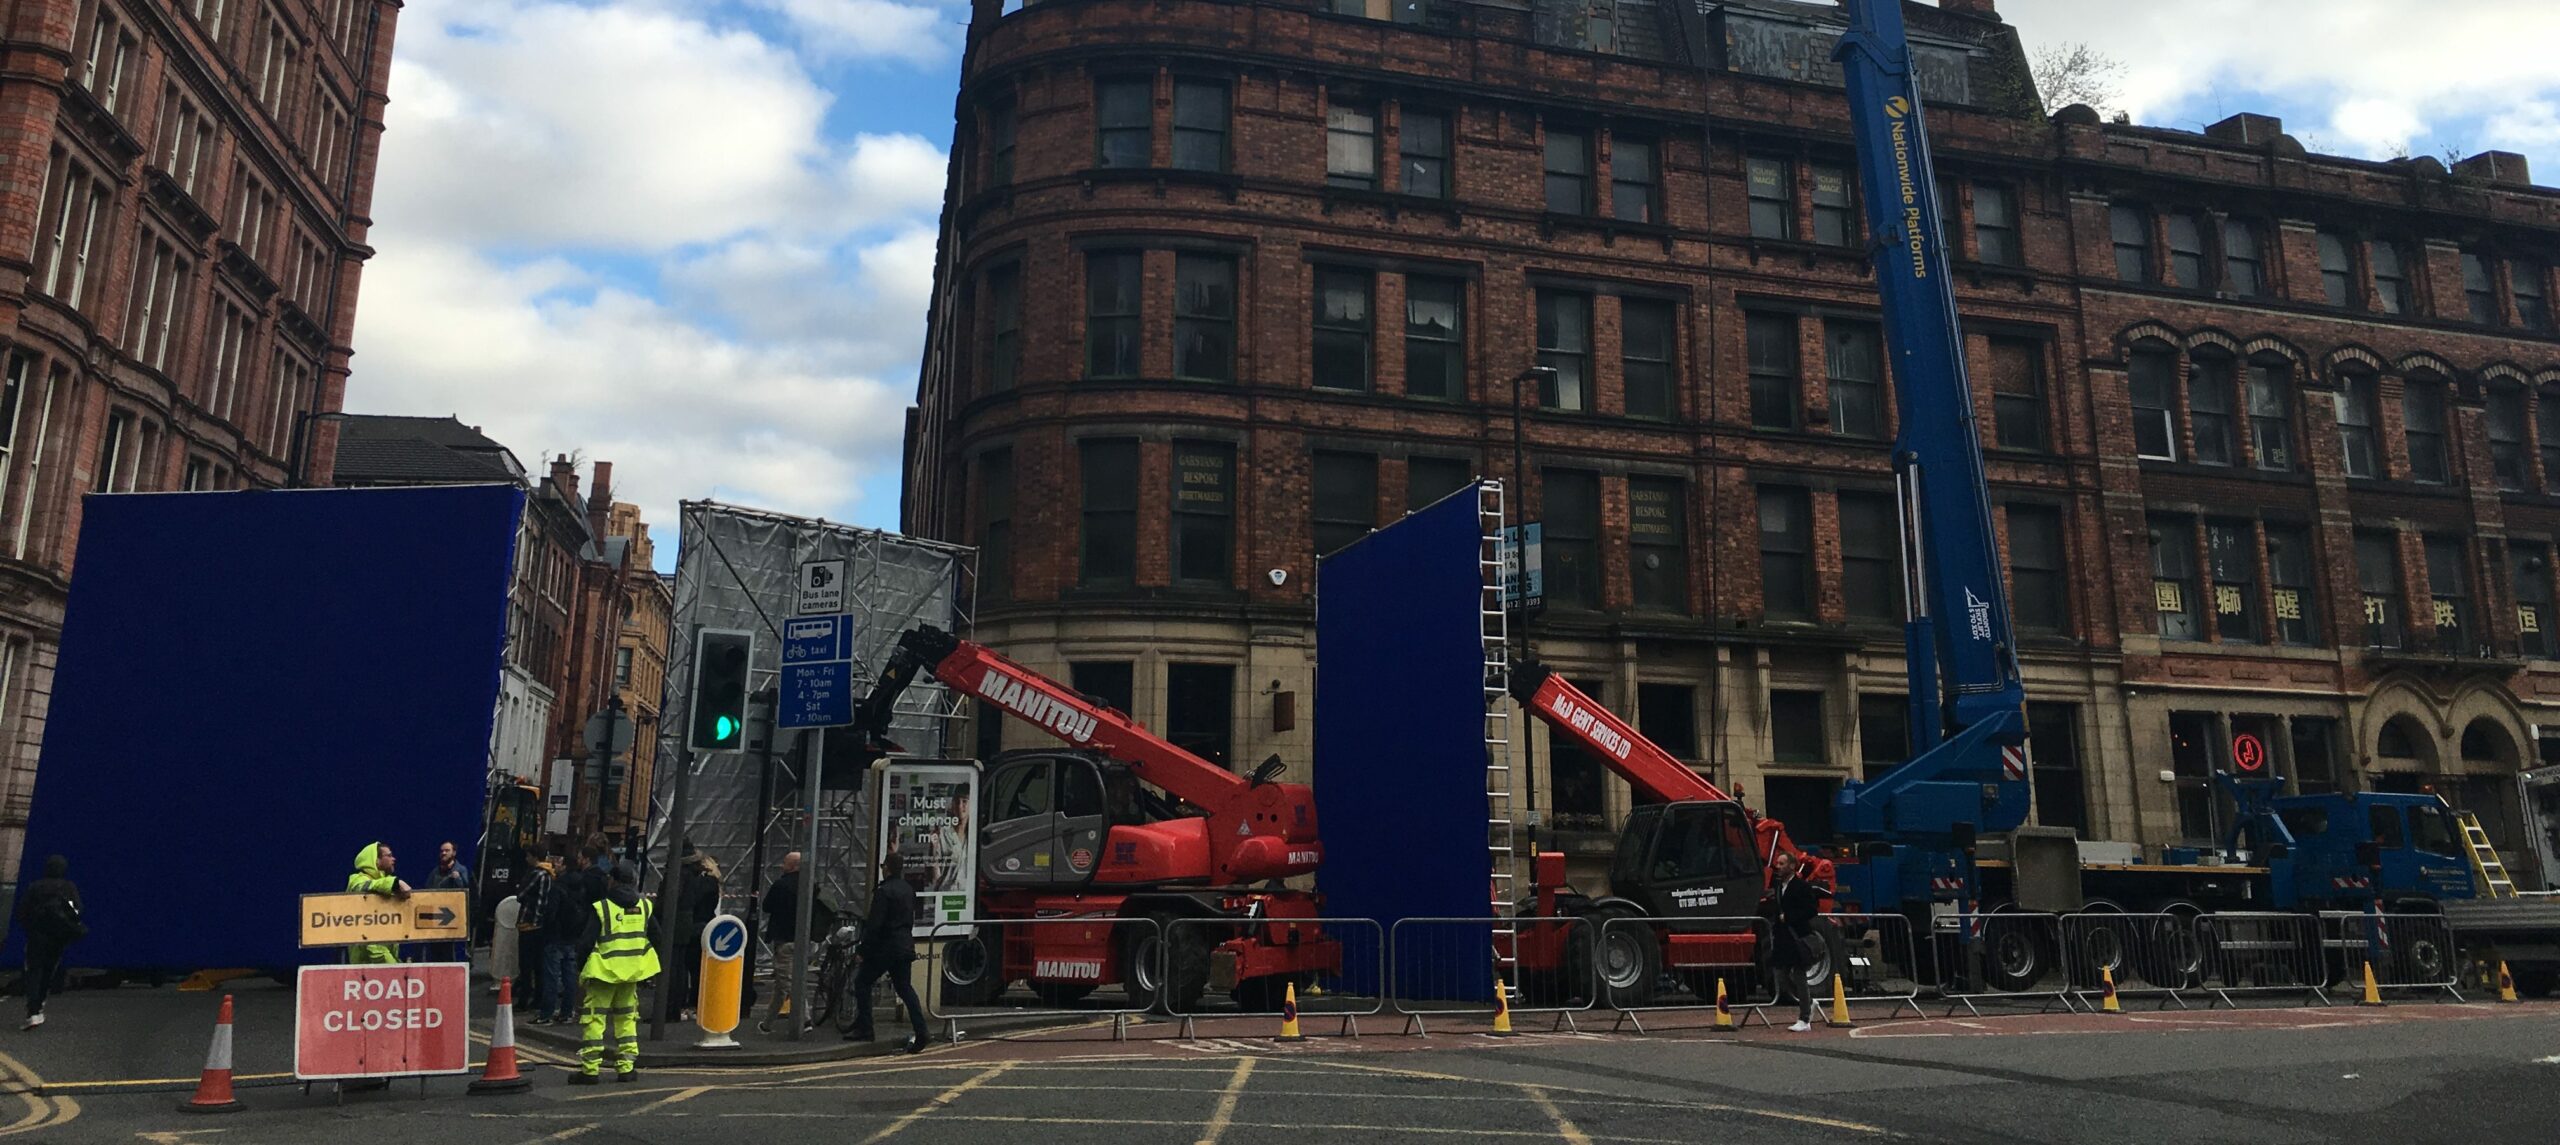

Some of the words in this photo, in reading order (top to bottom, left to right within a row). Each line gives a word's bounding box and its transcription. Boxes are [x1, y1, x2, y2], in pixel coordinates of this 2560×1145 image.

[1890, 121, 1917, 204] Nationwide
[1906, 207, 1926, 279] Platforms
[1183, 472, 1220, 485] BESPOKE
[1635, 506, 1667, 518] BESPOKE
[802, 590, 819, 599] Bus
[821, 589, 840, 598] lane
[802, 600, 838, 609] cameras
[2215, 585, 2242, 616] 獅
[2273, 589, 2301, 619] 醒
[2363, 596, 2386, 624] 打
[2432, 599, 2458, 628] 跌
[811, 644, 828, 655] taxi
[796, 668, 815, 678] Mon
[823, 666, 835, 676] Fri
[810, 679, 832, 688] 10am
[798, 690, 804, 699] 4
[812, 690, 830, 700] 7pm
[806, 701, 821, 711] Sat
[978, 669, 1098, 743] MANITOU
[808, 712, 832, 722] 10am
[1551, 692, 1575, 719] M&D
[1571, 706, 1596, 734] GENT
[1590, 720, 1622, 752] SERVICES
[1615, 737, 1632, 760] LTD
[913, 796, 946, 809] Must
[899, 813, 960, 826] challenge
[918, 833, 938, 843] me
[491, 868, 510, 879] JCB
[311, 910, 402, 929] Diversion
[1035, 961, 1101, 979] MANITOU
[343, 978, 426, 1001] ROAD
[323, 1007, 443, 1032] CLOSED
